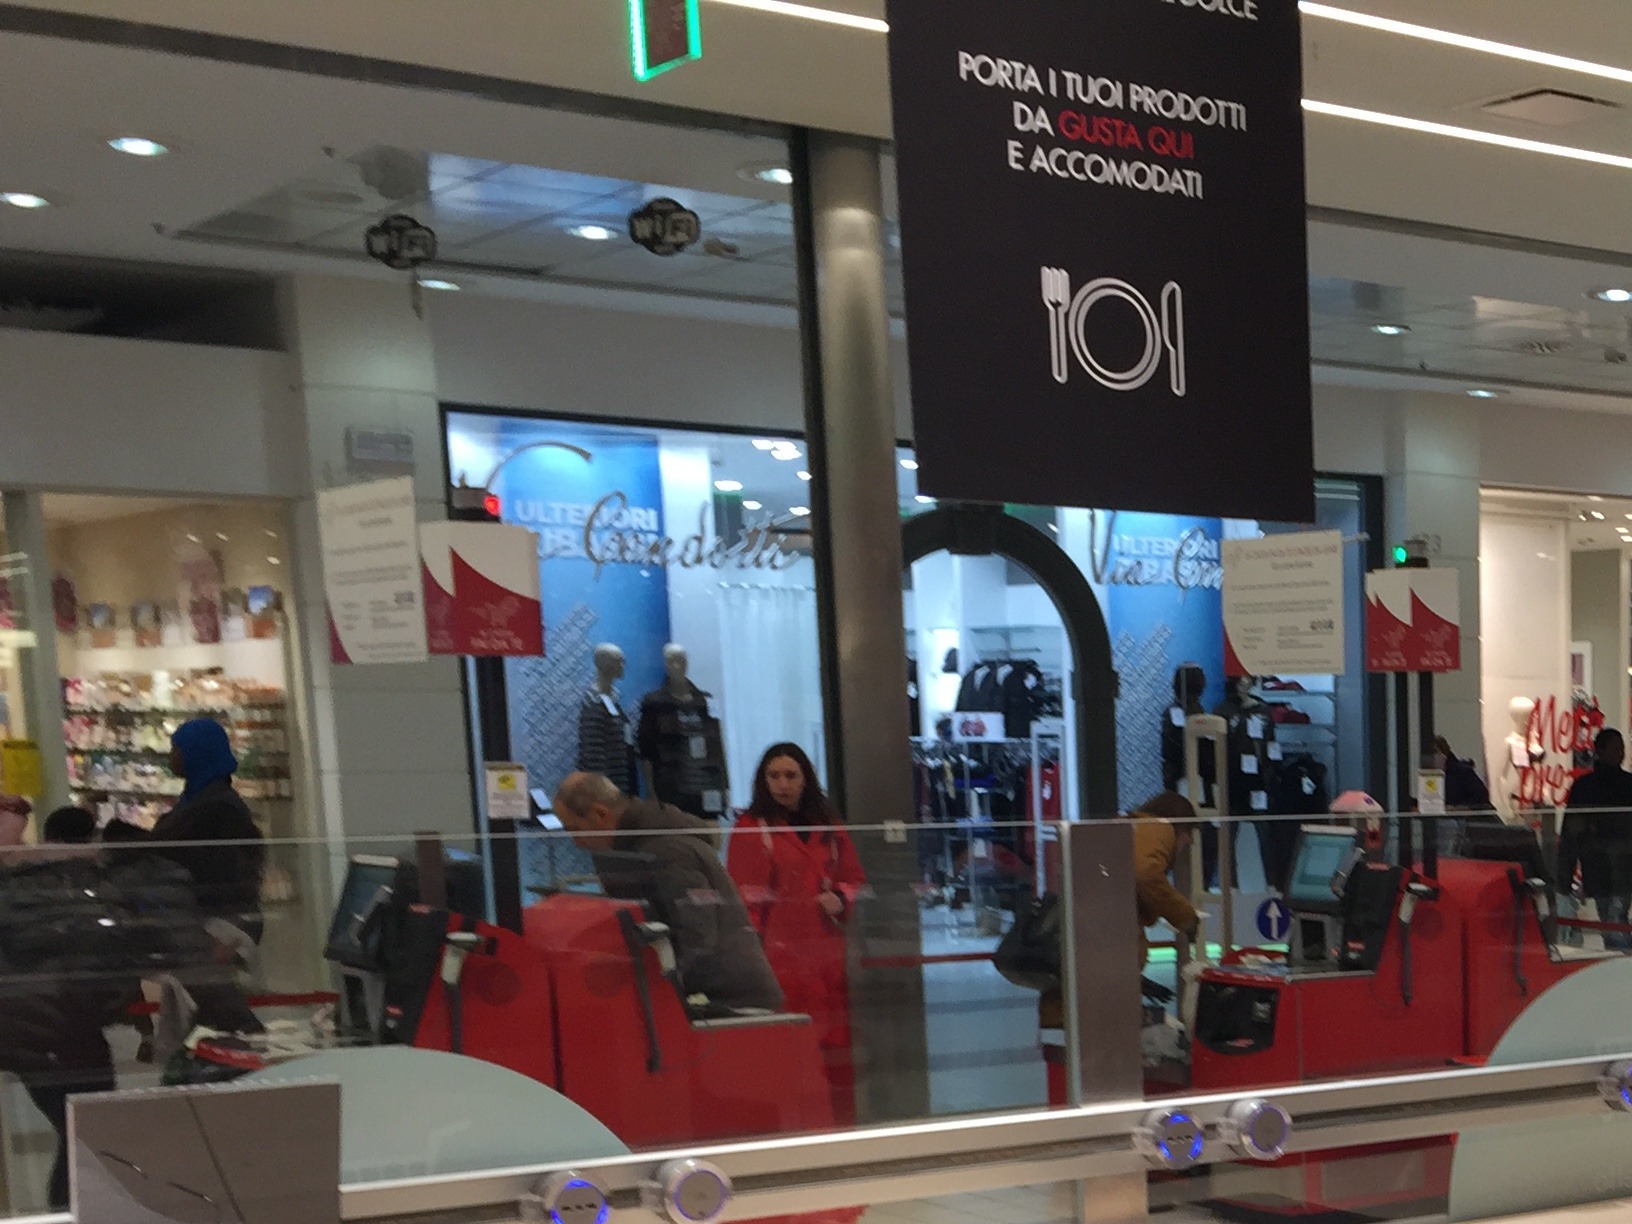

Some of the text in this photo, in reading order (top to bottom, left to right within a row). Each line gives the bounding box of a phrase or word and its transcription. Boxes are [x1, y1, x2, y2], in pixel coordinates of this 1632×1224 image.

[958, 50, 1247, 132] PORTA I TUOI PRODOTTI
[1012, 101, 1195, 159] DA GUSTA QUI
[1007, 139, 1204, 199] E ACCOMODATI
